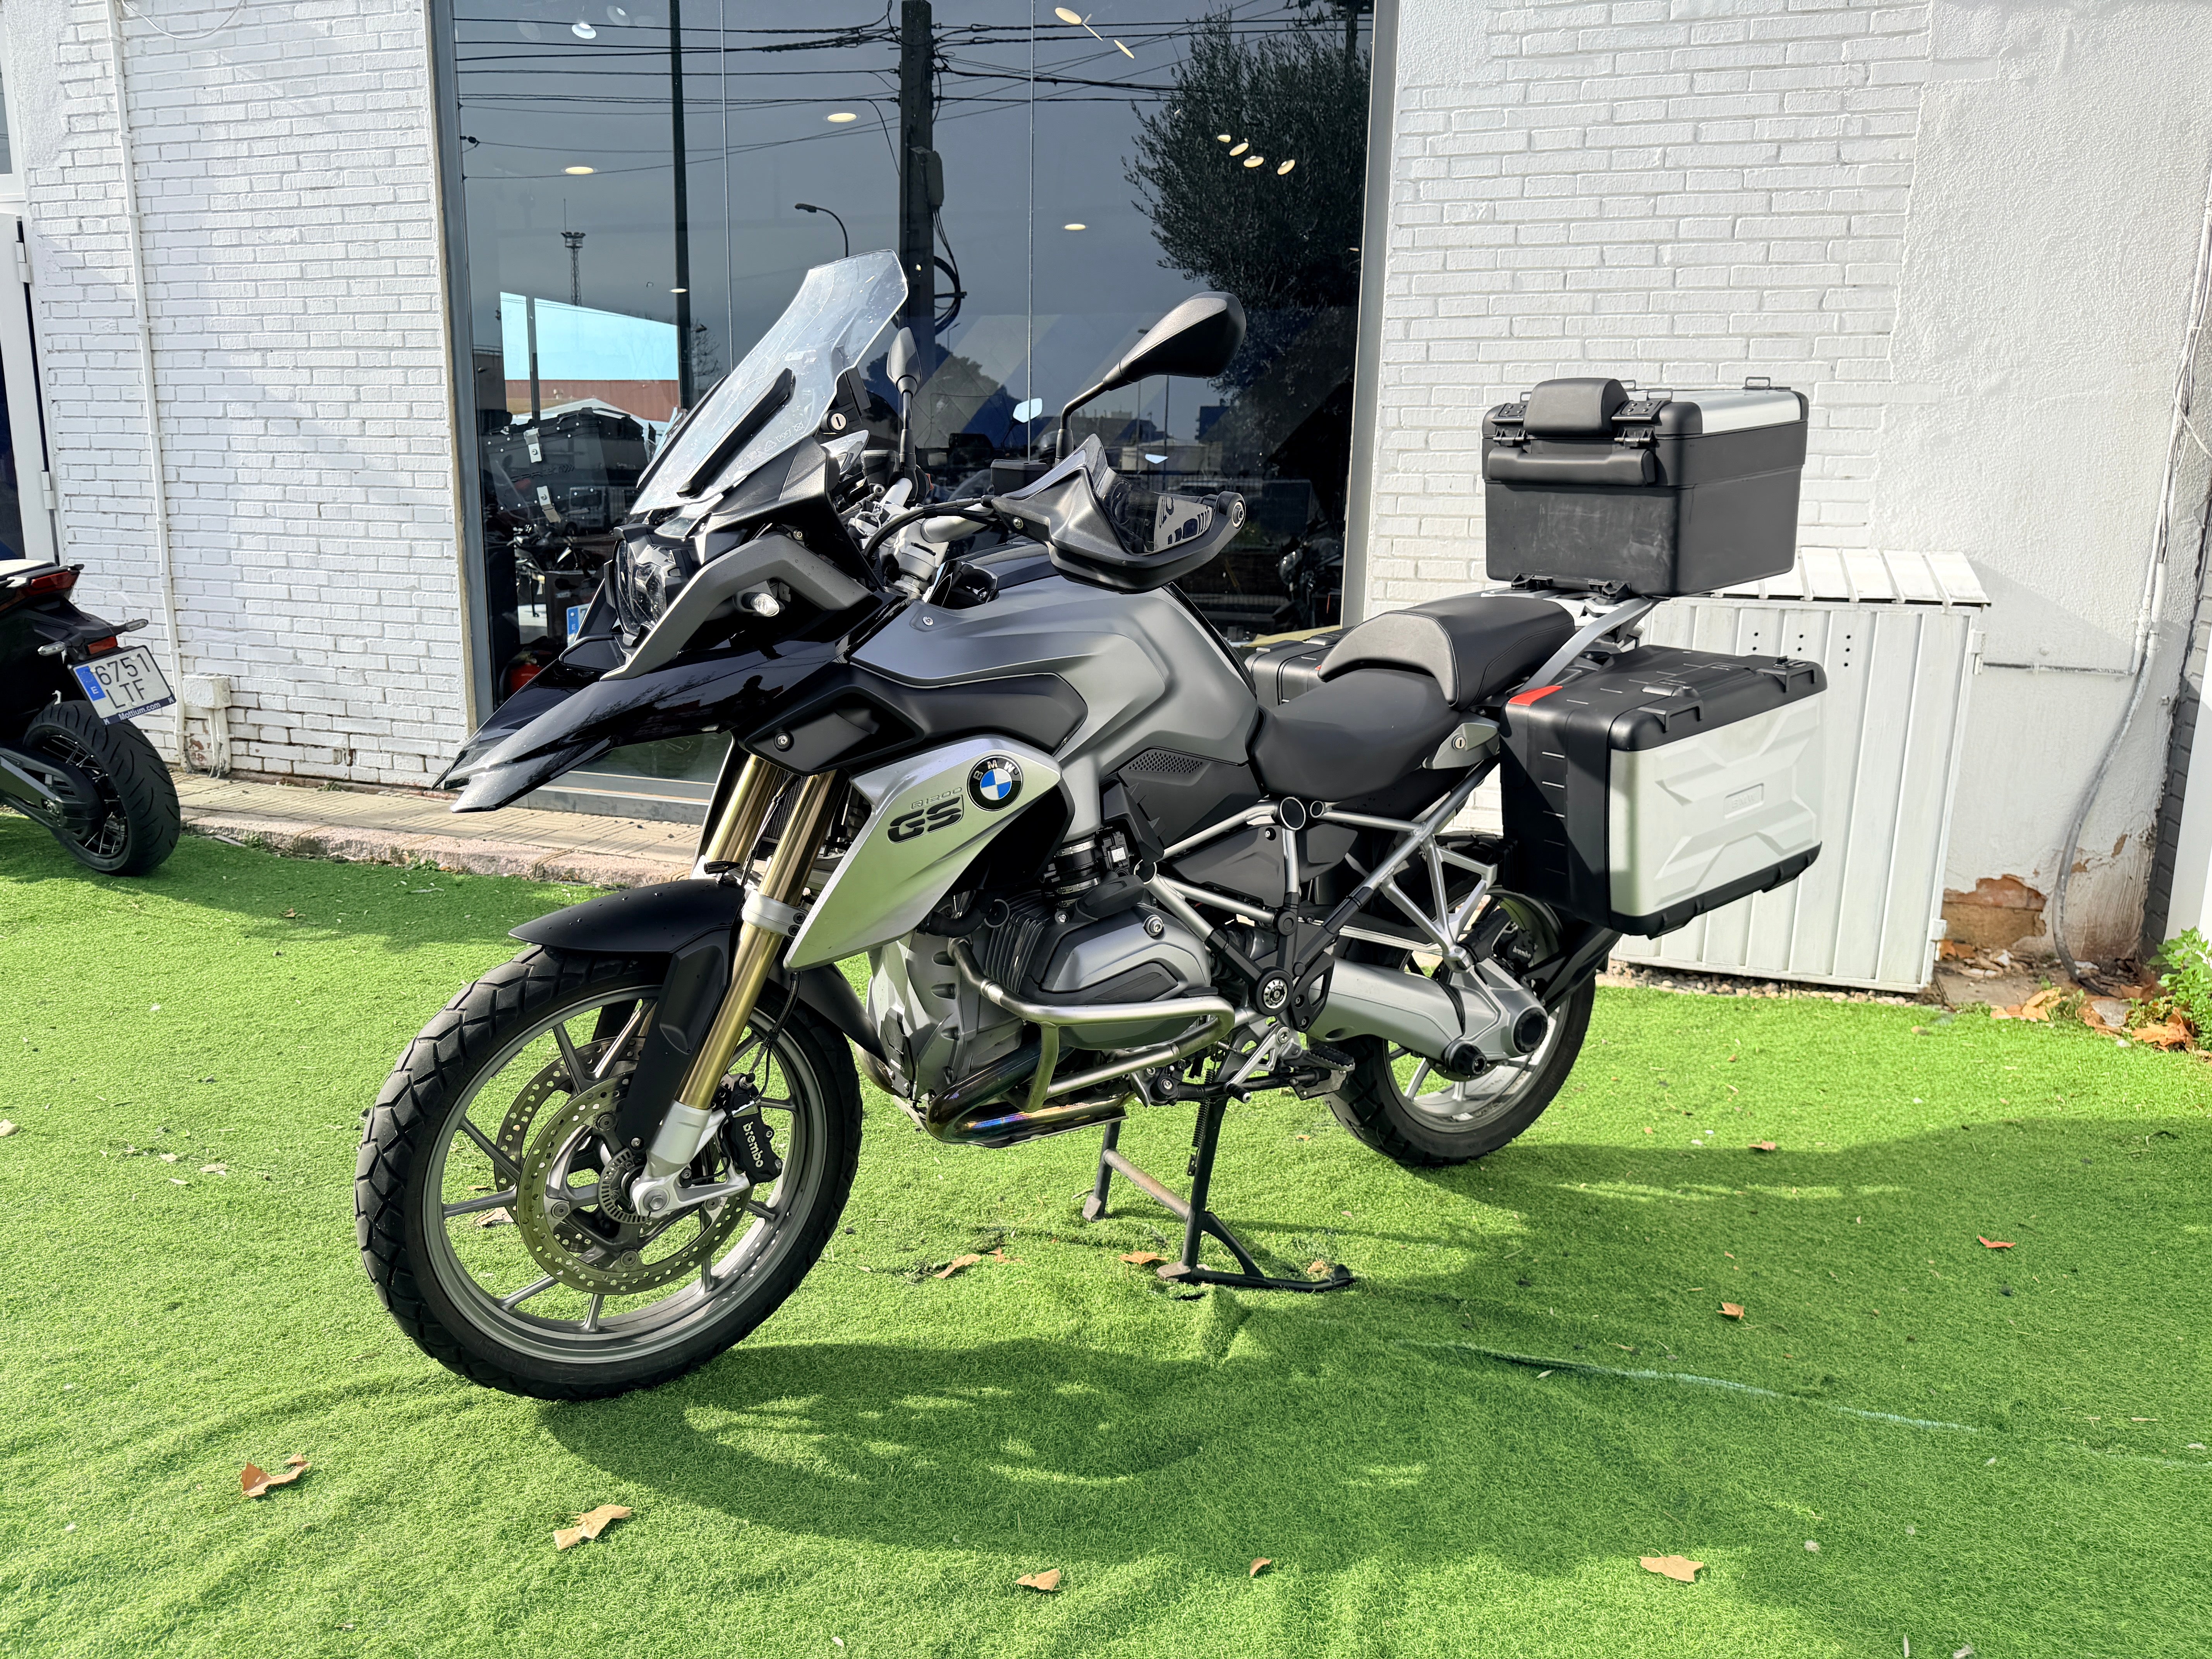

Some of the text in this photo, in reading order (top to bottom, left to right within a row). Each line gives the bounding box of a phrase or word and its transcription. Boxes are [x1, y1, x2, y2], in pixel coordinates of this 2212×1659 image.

[95, 653, 150, 685] 6751
[90, 686, 99, 695] E
[106, 678, 144, 709] LTF
[118, 702, 161, 721] Mottium.com
[973, 759, 1015, 781] BMW
[887, 796, 963, 843] GS
[742, 1121, 764, 1168] brembo
